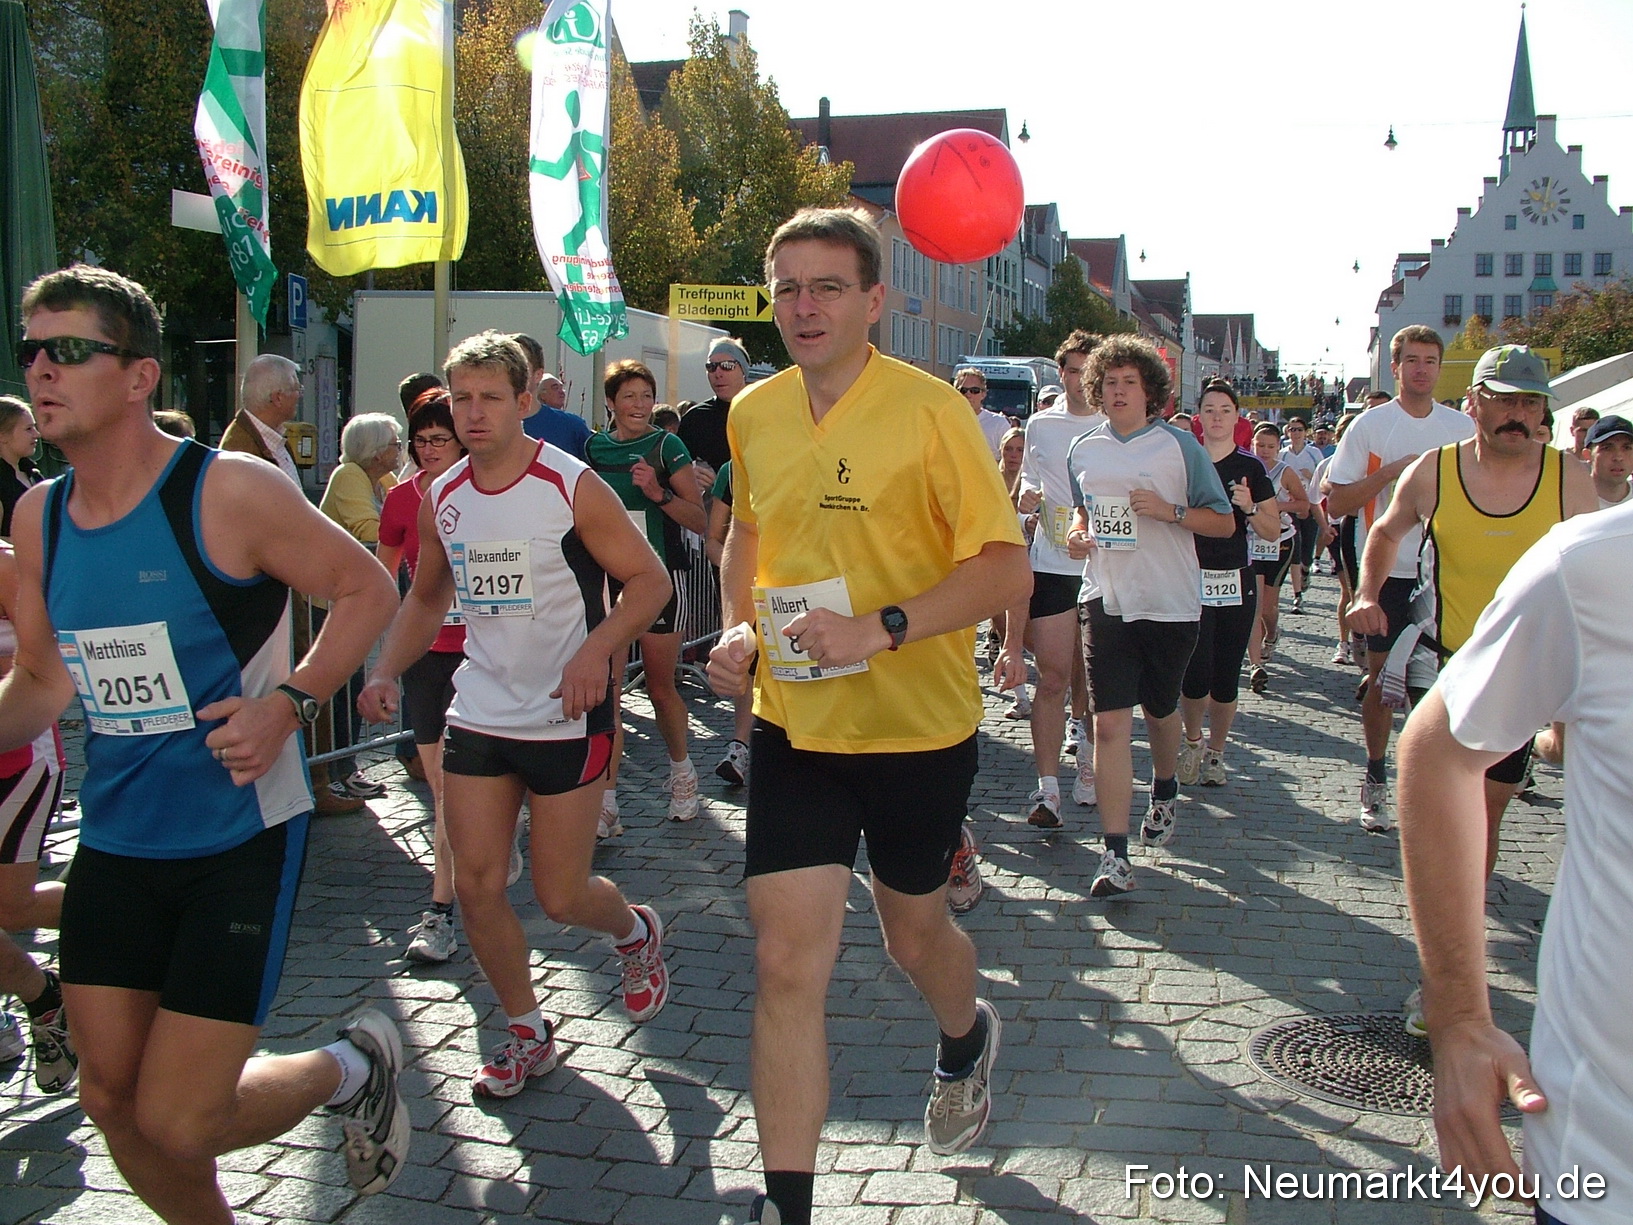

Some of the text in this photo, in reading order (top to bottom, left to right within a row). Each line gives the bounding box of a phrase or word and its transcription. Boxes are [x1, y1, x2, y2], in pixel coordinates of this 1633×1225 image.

[292, 282, 303, 320] P
[678, 288, 745, 302] Treffpunkt
[677, 304, 750, 318] Bladenight
[1258, 398, 1286, 406] START
[824, 494, 861, 503] SportGruppe
[1094, 504, 1130, 518] ALEX
[1095, 519, 1132, 535] 3548
[468, 548, 521, 563] Alexander
[1254, 544, 1277, 554] 2812
[1203, 569, 1236, 579] Alexandra
[472, 574, 524, 596] 2197
[1205, 583, 1237, 596] 3120
[771, 597, 809, 614] Albert
[83, 638, 147, 660] Matthias
[98, 672, 171, 706] 2051
